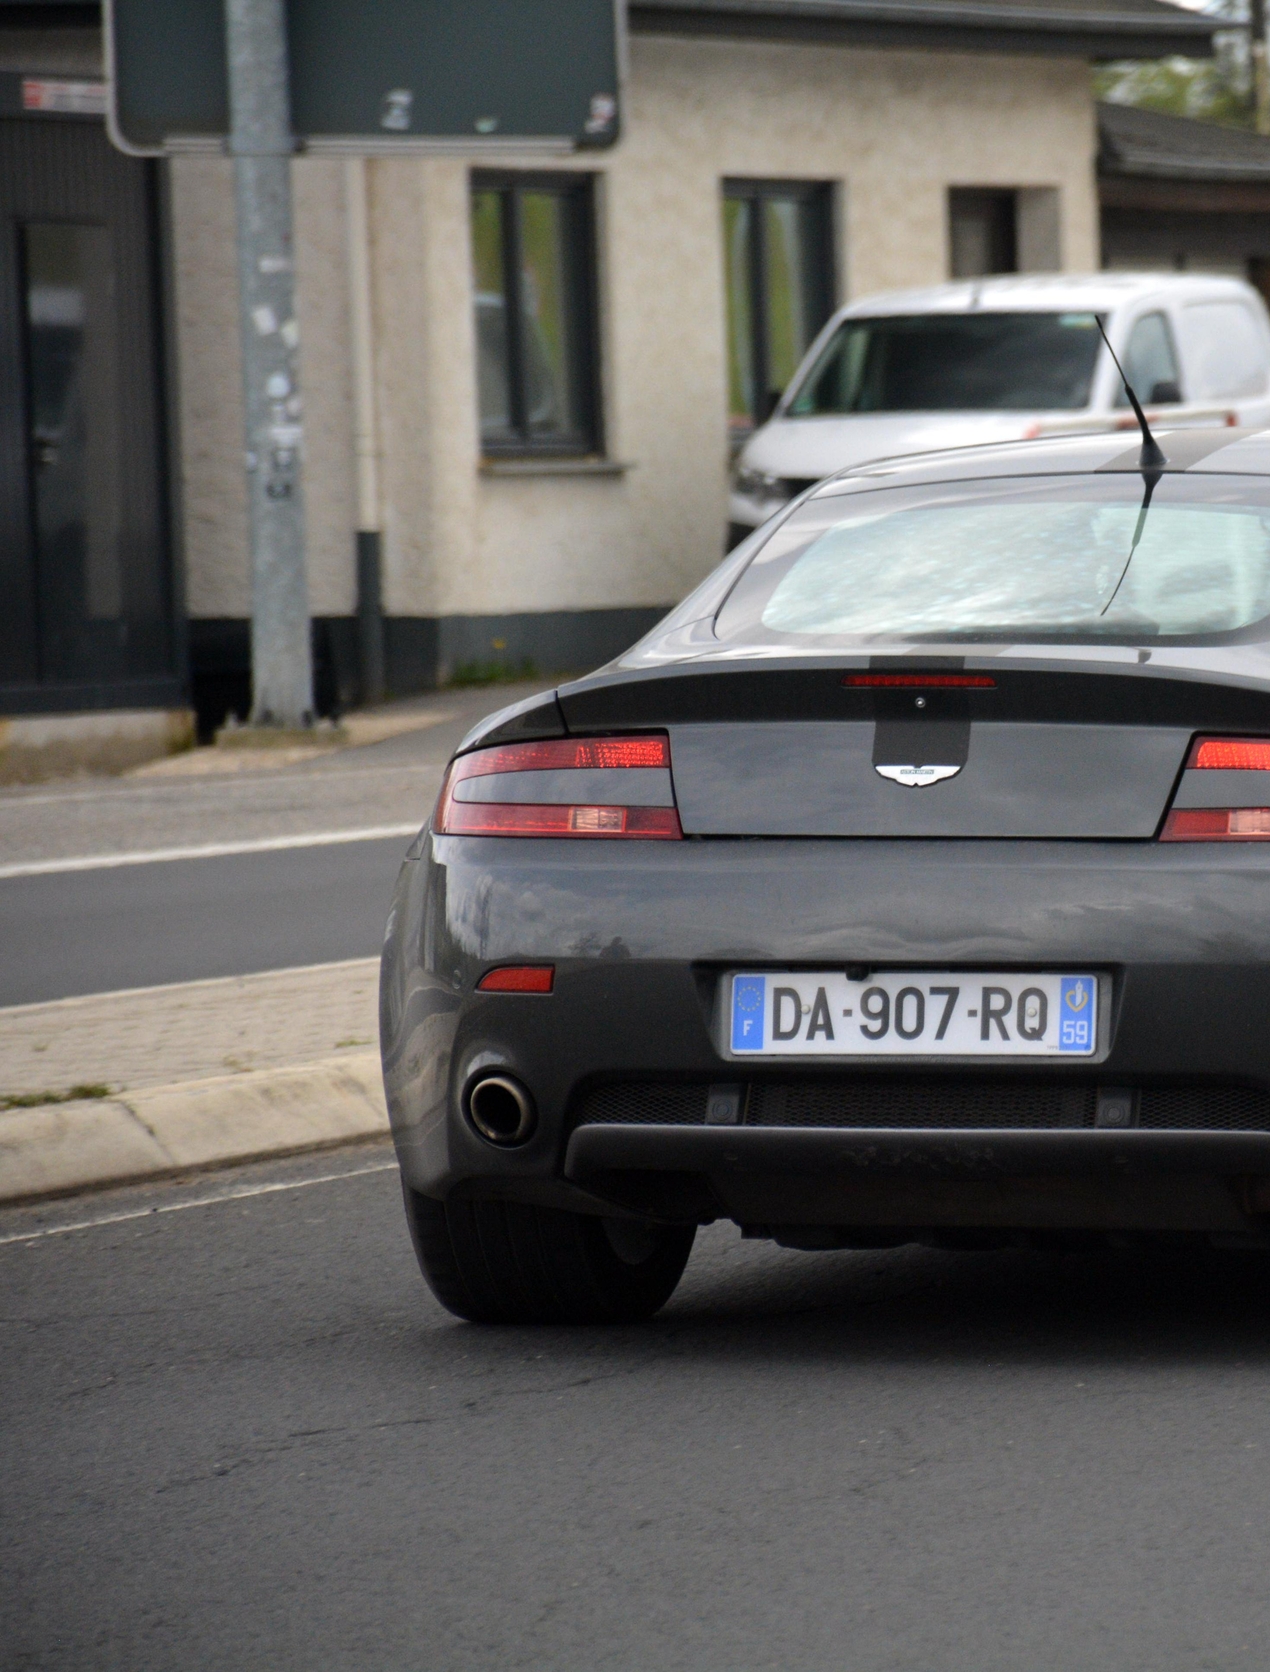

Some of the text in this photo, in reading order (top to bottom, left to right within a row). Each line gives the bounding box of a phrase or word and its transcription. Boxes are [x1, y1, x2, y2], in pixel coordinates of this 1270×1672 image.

[771, 985, 1048, 1042] DA-907-RQ
[743, 1020, 753, 1037] F
[1062, 1020, 1089, 1045] 59
